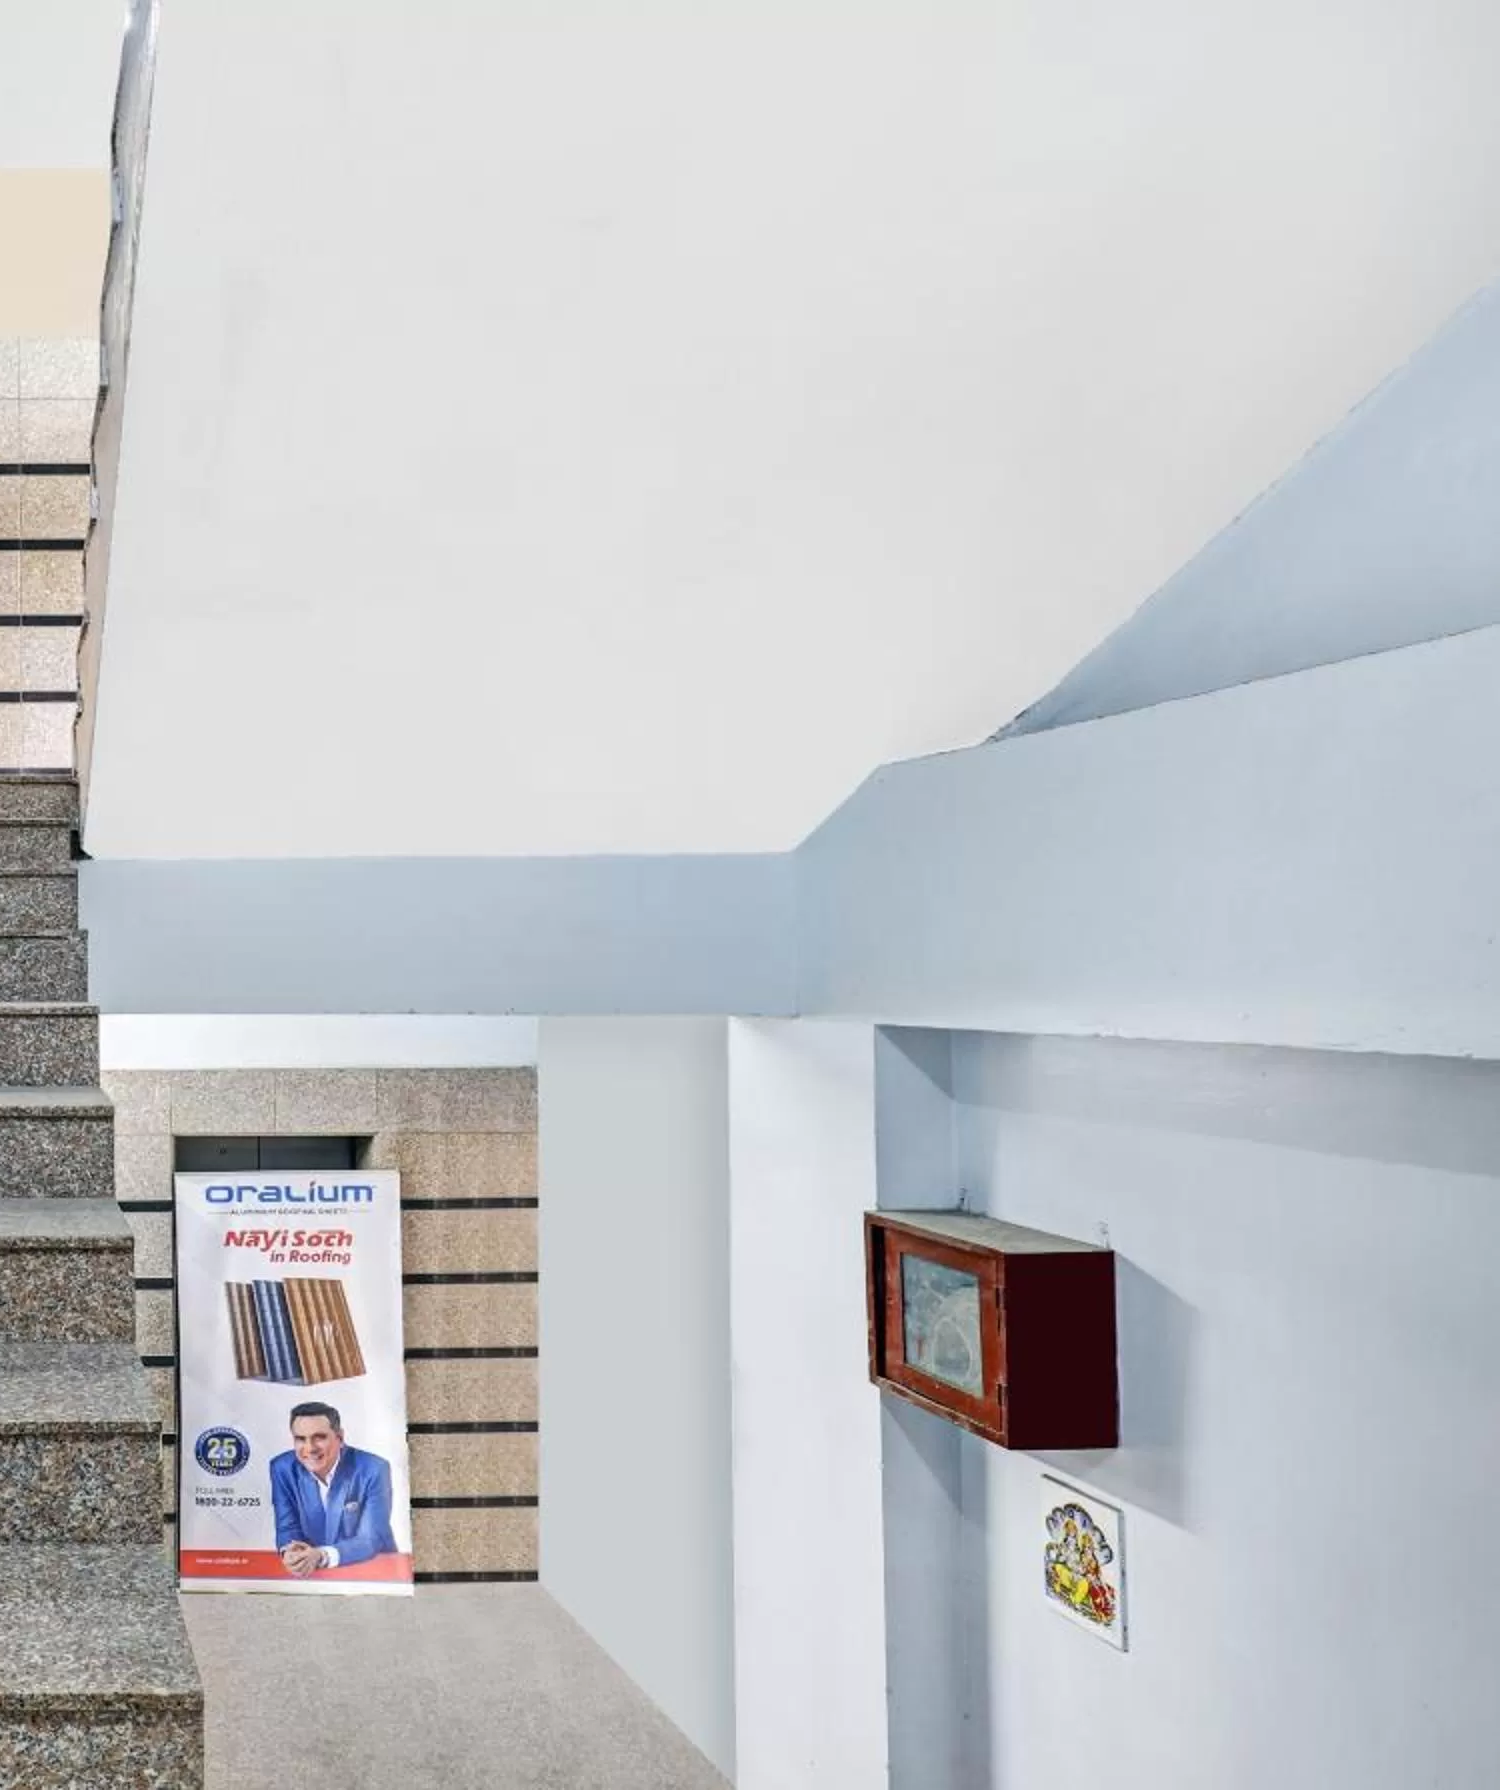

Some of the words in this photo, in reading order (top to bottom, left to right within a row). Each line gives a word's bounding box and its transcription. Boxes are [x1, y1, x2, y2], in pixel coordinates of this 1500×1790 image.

[291, 1230, 353, 1247] Soch
[269, 1250, 285, 1263] in
[289, 1249, 352, 1265] Roofing
[207, 1438, 237, 1459] 25
